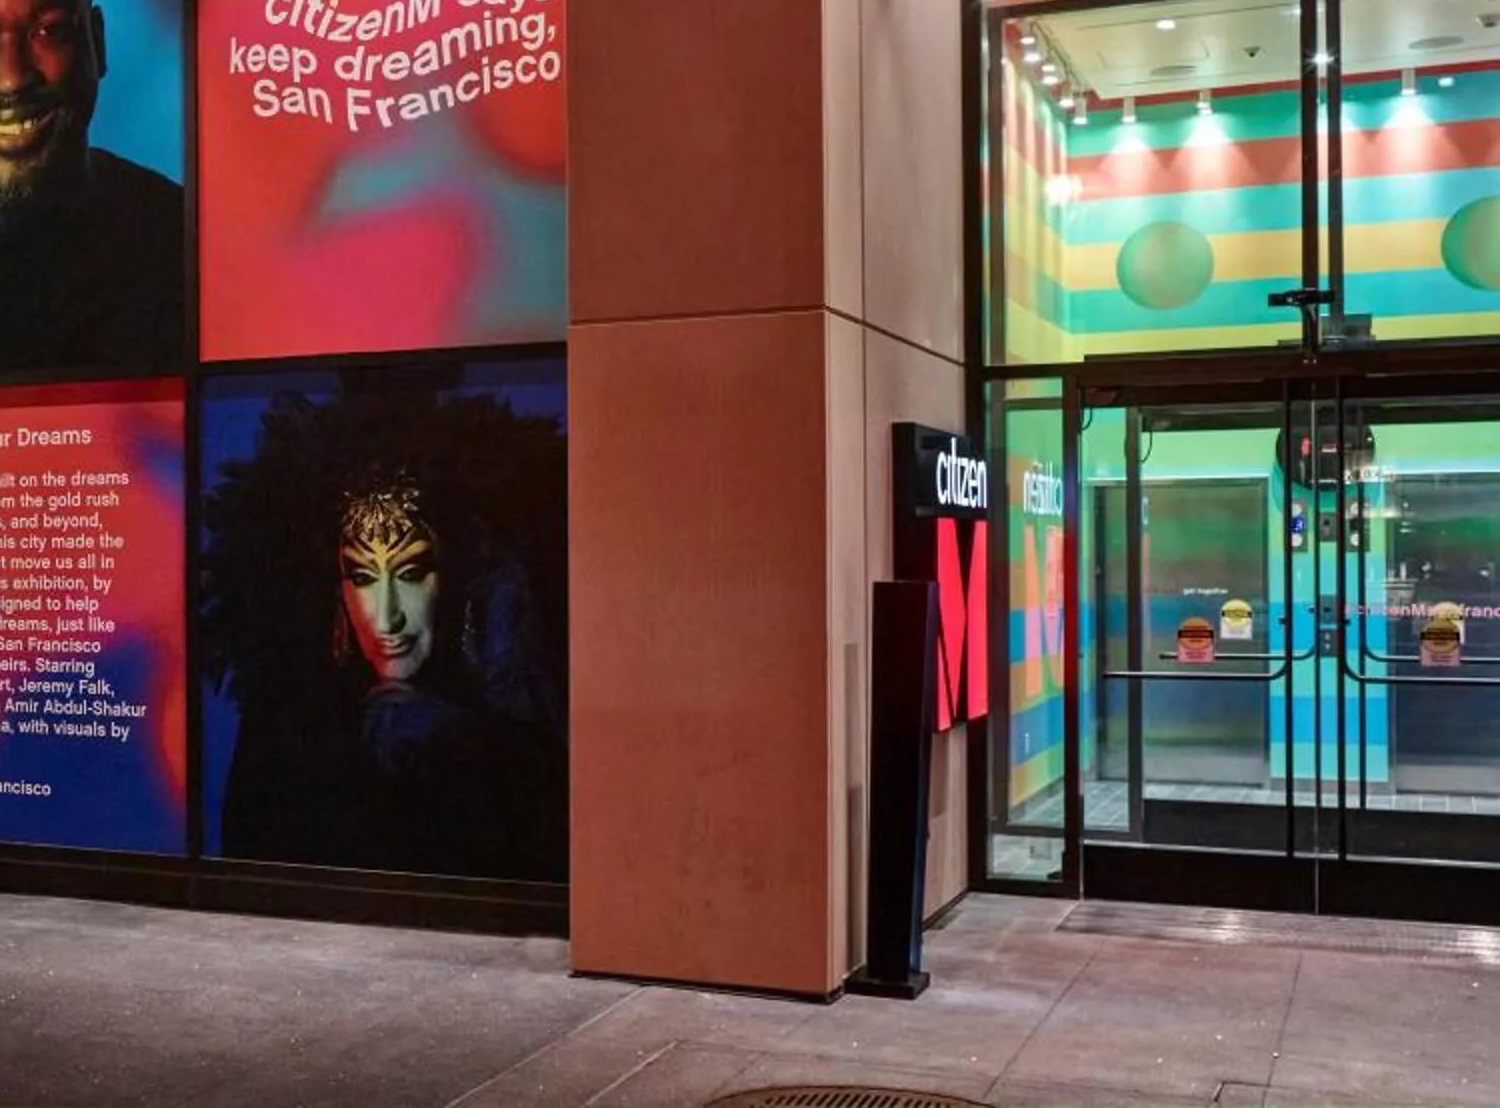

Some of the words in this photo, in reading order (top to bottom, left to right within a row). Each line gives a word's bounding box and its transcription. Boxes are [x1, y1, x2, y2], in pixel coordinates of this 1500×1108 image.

[229, 37, 317, 83] keep
[333, 11, 556, 82] dreaming,
[253, 79, 333, 125] San
[345, 52, 561, 132] Francisco
[17, 428, 93, 447] Dreams
[19, 476, 38, 487] on
[41, 472, 66, 486] the
[71, 471, 131, 486] dreams
[936, 437, 987, 509] citizen
[20, 493, 45, 507] the
[48, 493, 81, 511] gold
[86, 492, 119, 506] rush
[10, 515, 38, 529] and
[43, 513, 103, 532] beyond,
[20, 534, 47, 552] city
[51, 534, 94, 548] made
[99, 533, 124, 549] the
[10, 558, 50, 569] move
[56, 558, 73, 569] us
[78, 554, 96, 569] all
[100, 555, 114, 569] in
[13, 575, 88, 592] exhibition,
[93, 575, 112, 595] by
[46, 598, 62, 611] to
[65, 597, 99, 614] help
[56, 617, 84, 635] just
[88, 616, 115, 633] like
[937, 517, 988, 732] M
[28, 637, 101, 653] Francisco
[36, 658, 95, 678] Starring
[18, 678, 74, 698] Jeremy
[79, 679, 115, 698] Falk,
[4, 699, 39, 713] Amir
[44, 700, 147, 717] Abdul-Shakur
[18, 719, 49, 735] with
[53, 722, 106, 737] visuals
[111, 724, 130, 743] by
